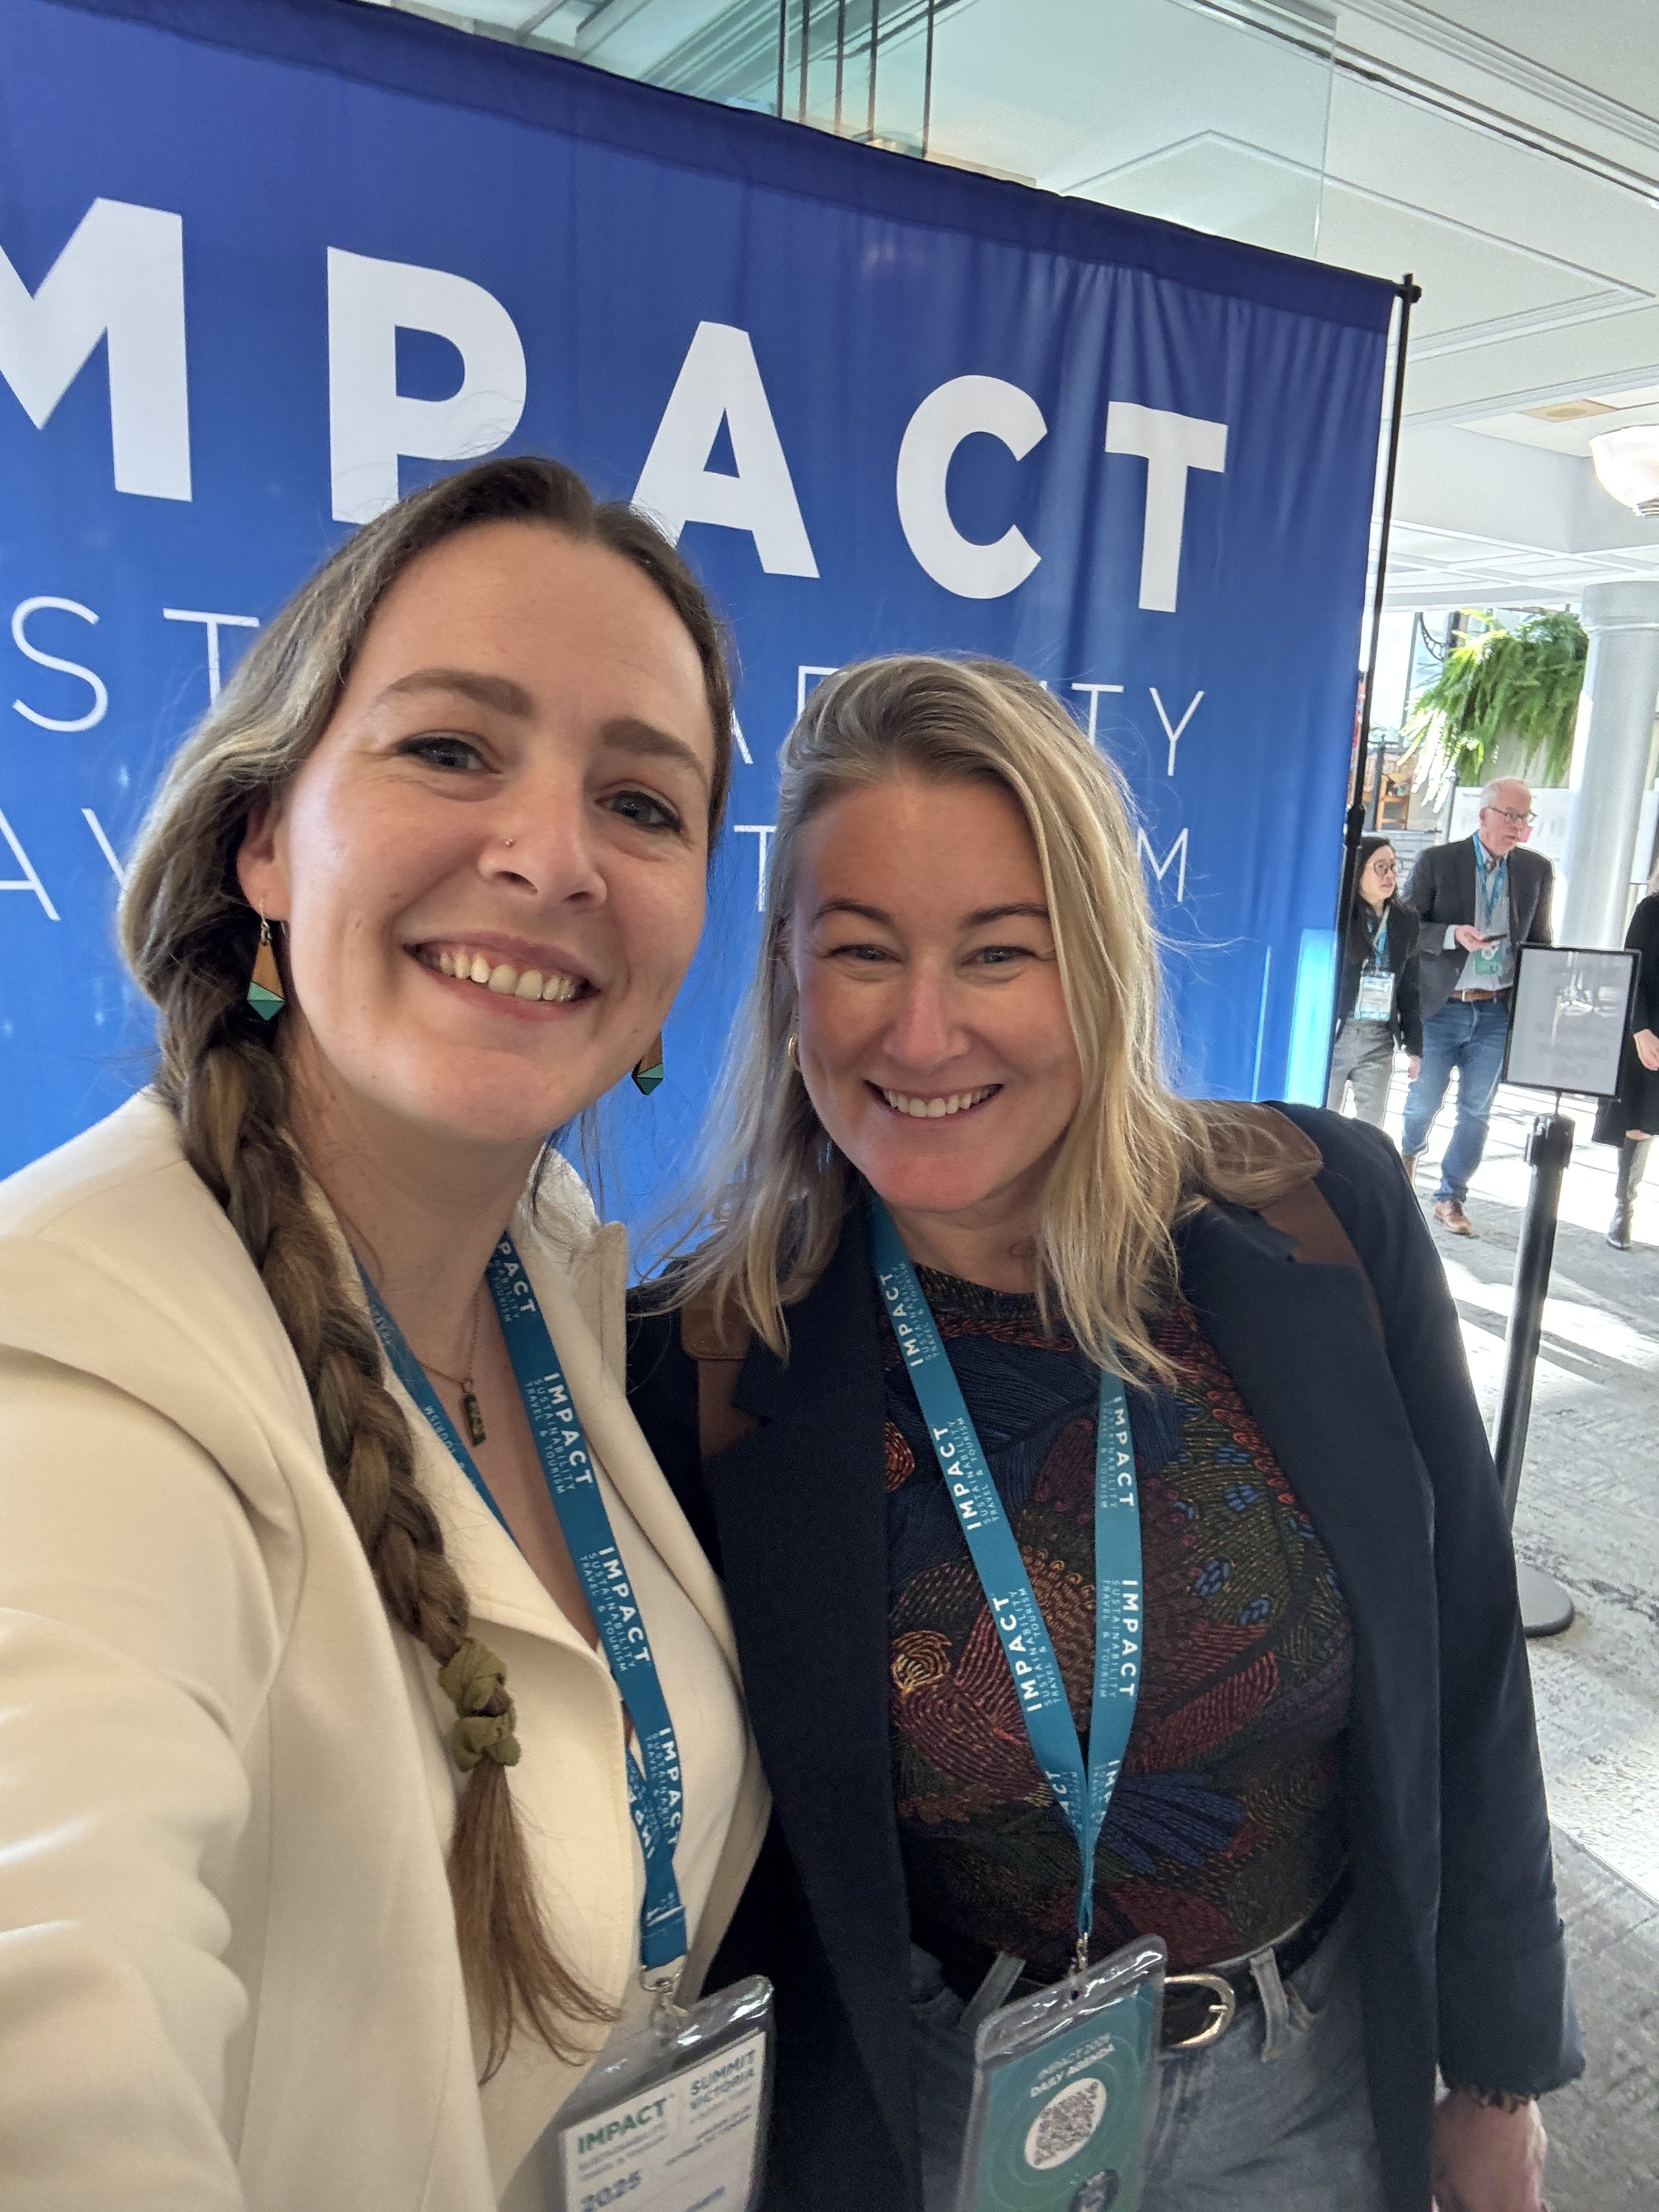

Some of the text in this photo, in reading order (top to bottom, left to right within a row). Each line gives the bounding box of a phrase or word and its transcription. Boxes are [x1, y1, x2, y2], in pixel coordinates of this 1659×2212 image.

[496, 1241, 536, 1312] PACT
[880, 1273, 924, 1367] IMPACT
[544, 1372, 592, 1483] IMPACT
[933, 1427, 981, 1530] IMPACT
[947, 1421, 991, 1524] SUSTAINABILITY
[957, 1417, 978, 1462] TOURISM
[1114, 1396, 1134, 1506] IMPACT
[981, 1484, 1000, 1522] TRAVEL
[579, 1556, 600, 1596] TRAVEL
[603, 1621, 628, 1671] TOURISM
[589, 1553, 636, 1667] SUSTAINABILITY
[598, 1547, 650, 1661] IMPACT
[992, 1598, 1042, 1712] IMPACT
[1008, 1591, 1052, 1706] SUSTAINABILITY
[1018, 1588, 1041, 1638] TOURISM
[1119, 1580, 1139, 1696] IMPACT
[1044, 1663, 1061, 1703] TRAVEL
[578, 2097, 668, 2154] IMPACT
